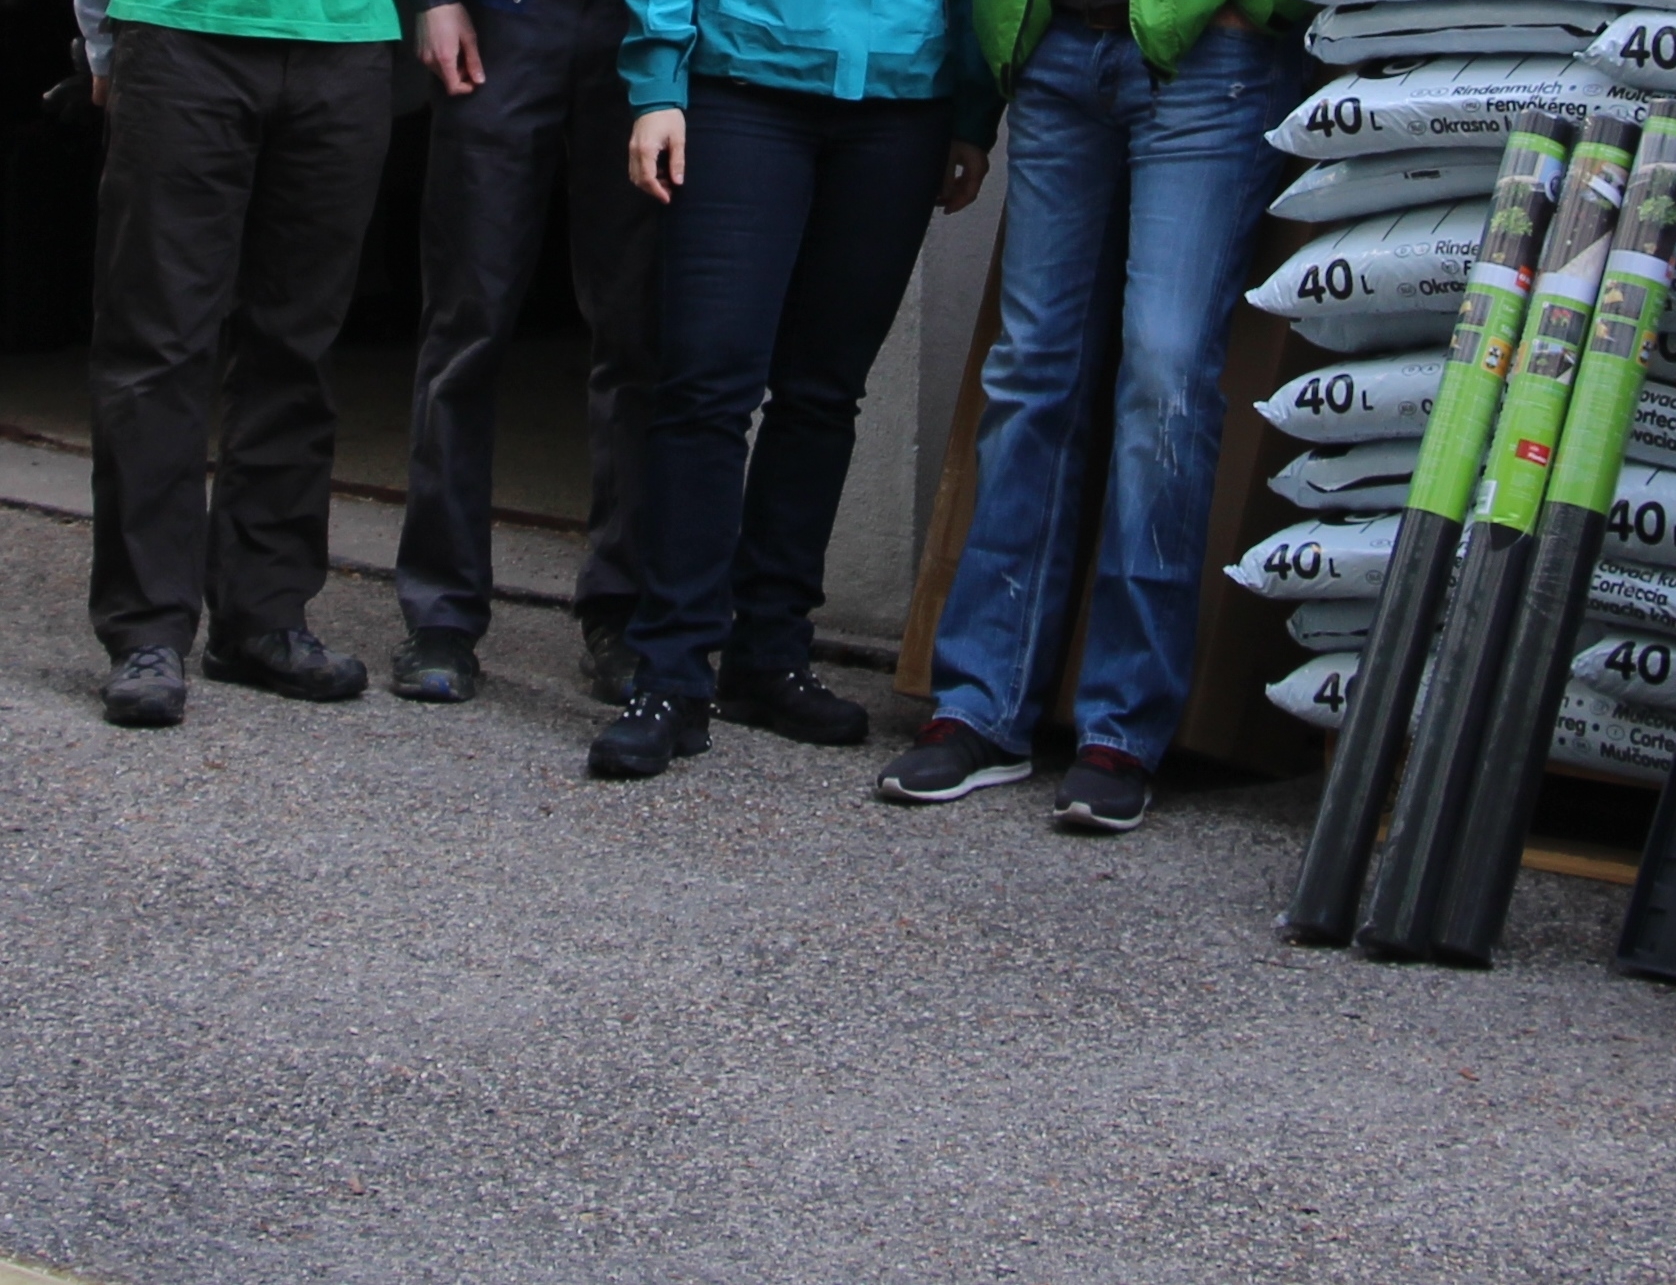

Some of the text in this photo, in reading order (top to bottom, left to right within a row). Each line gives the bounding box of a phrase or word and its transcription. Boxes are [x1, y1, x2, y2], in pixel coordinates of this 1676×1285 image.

[1451, 81, 1563, 96] Rindenmulch
[1305, 97, 1383, 137] 40 L
[1430, 116, 1499, 135] Okrasno
[1298, 258, 1374, 304] 40 L
[1295, 374, 1374, 415] 40 L
[1607, 499, 1666, 545] 40
[1263, 541, 1341, 581] 40 L
[1604, 640, 1671, 685] 40
